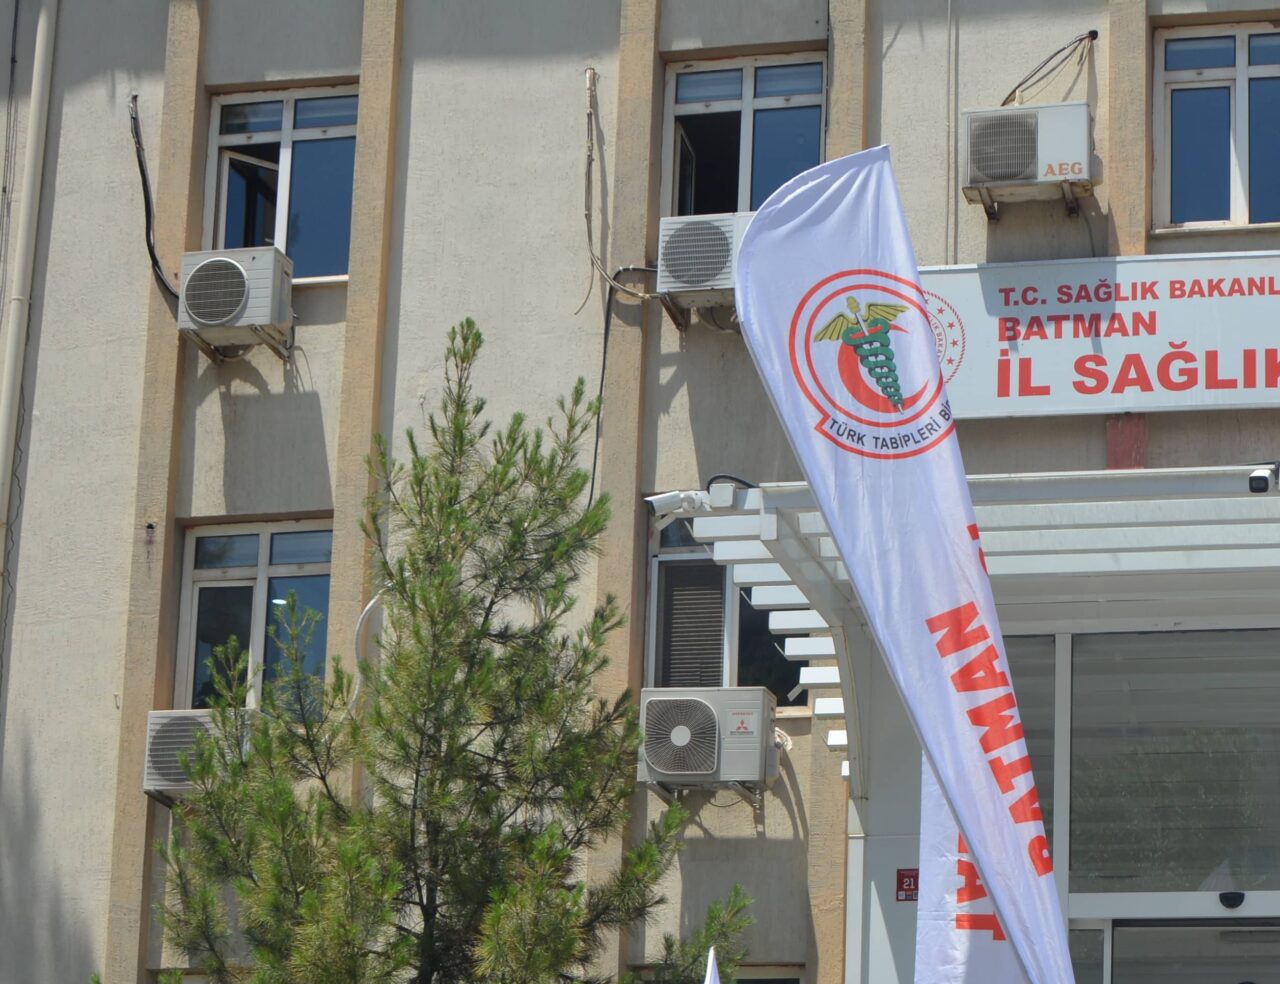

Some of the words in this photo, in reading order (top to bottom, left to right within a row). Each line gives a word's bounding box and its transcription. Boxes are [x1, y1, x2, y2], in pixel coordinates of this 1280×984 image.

[1044, 162, 1083, 176] AEG
[998, 286, 1047, 306] T.C.
[1056, 279, 1160, 304] SAĞLIK
[998, 311, 1157, 342] BATMAN
[997, 348, 1051, 398] İL
[829, 417, 867, 447] TÜRK
[872, 416, 942, 450] TABİPLERİ
[903, 877, 916, 889] 21
